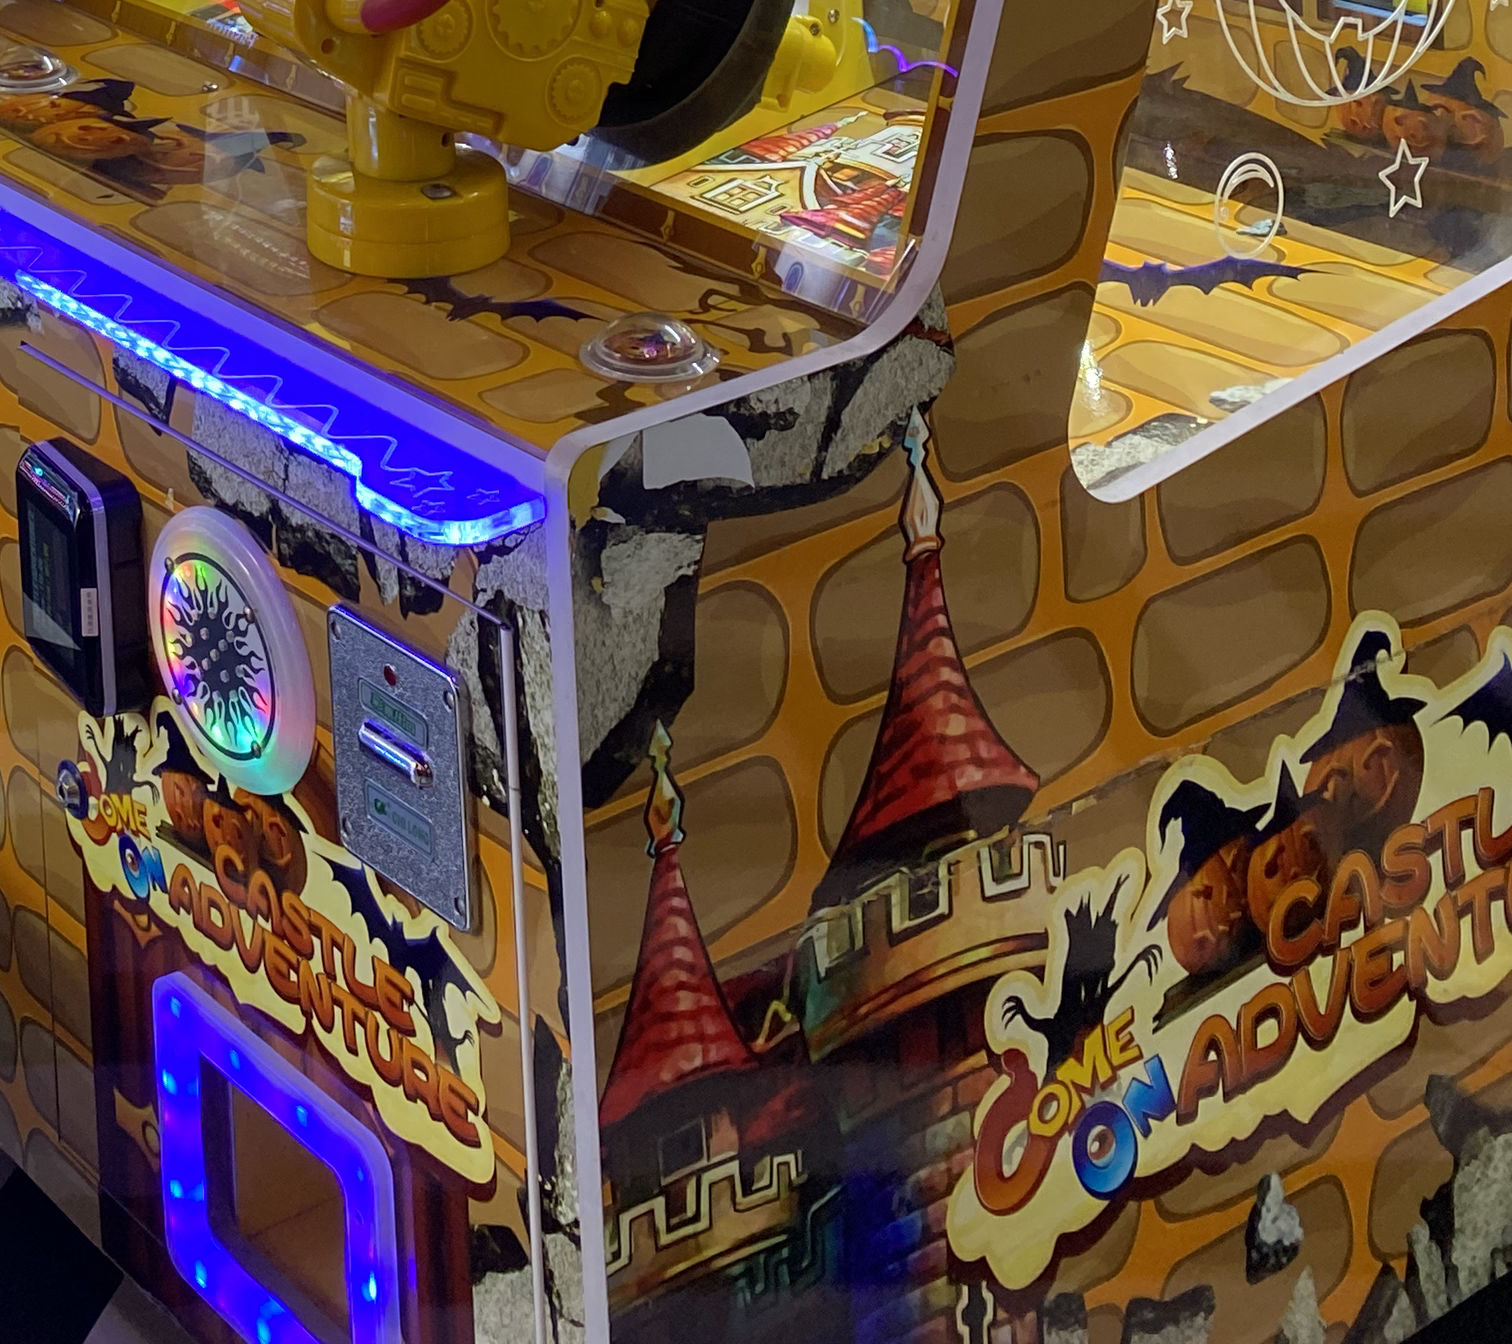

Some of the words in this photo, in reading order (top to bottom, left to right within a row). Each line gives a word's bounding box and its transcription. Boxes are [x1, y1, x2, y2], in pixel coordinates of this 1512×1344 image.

[118, 833, 168, 902] ON
[215, 844, 415, 1039] CASTLE
[1266, 786, 1512, 980] CASTL
[166, 863, 482, 1150] ADVENTURE
[1071, 1053, 1178, 1202] ON
[1176, 858, 1512, 1126] ADVENT
[972, 1007, 1144, 1216] COME
